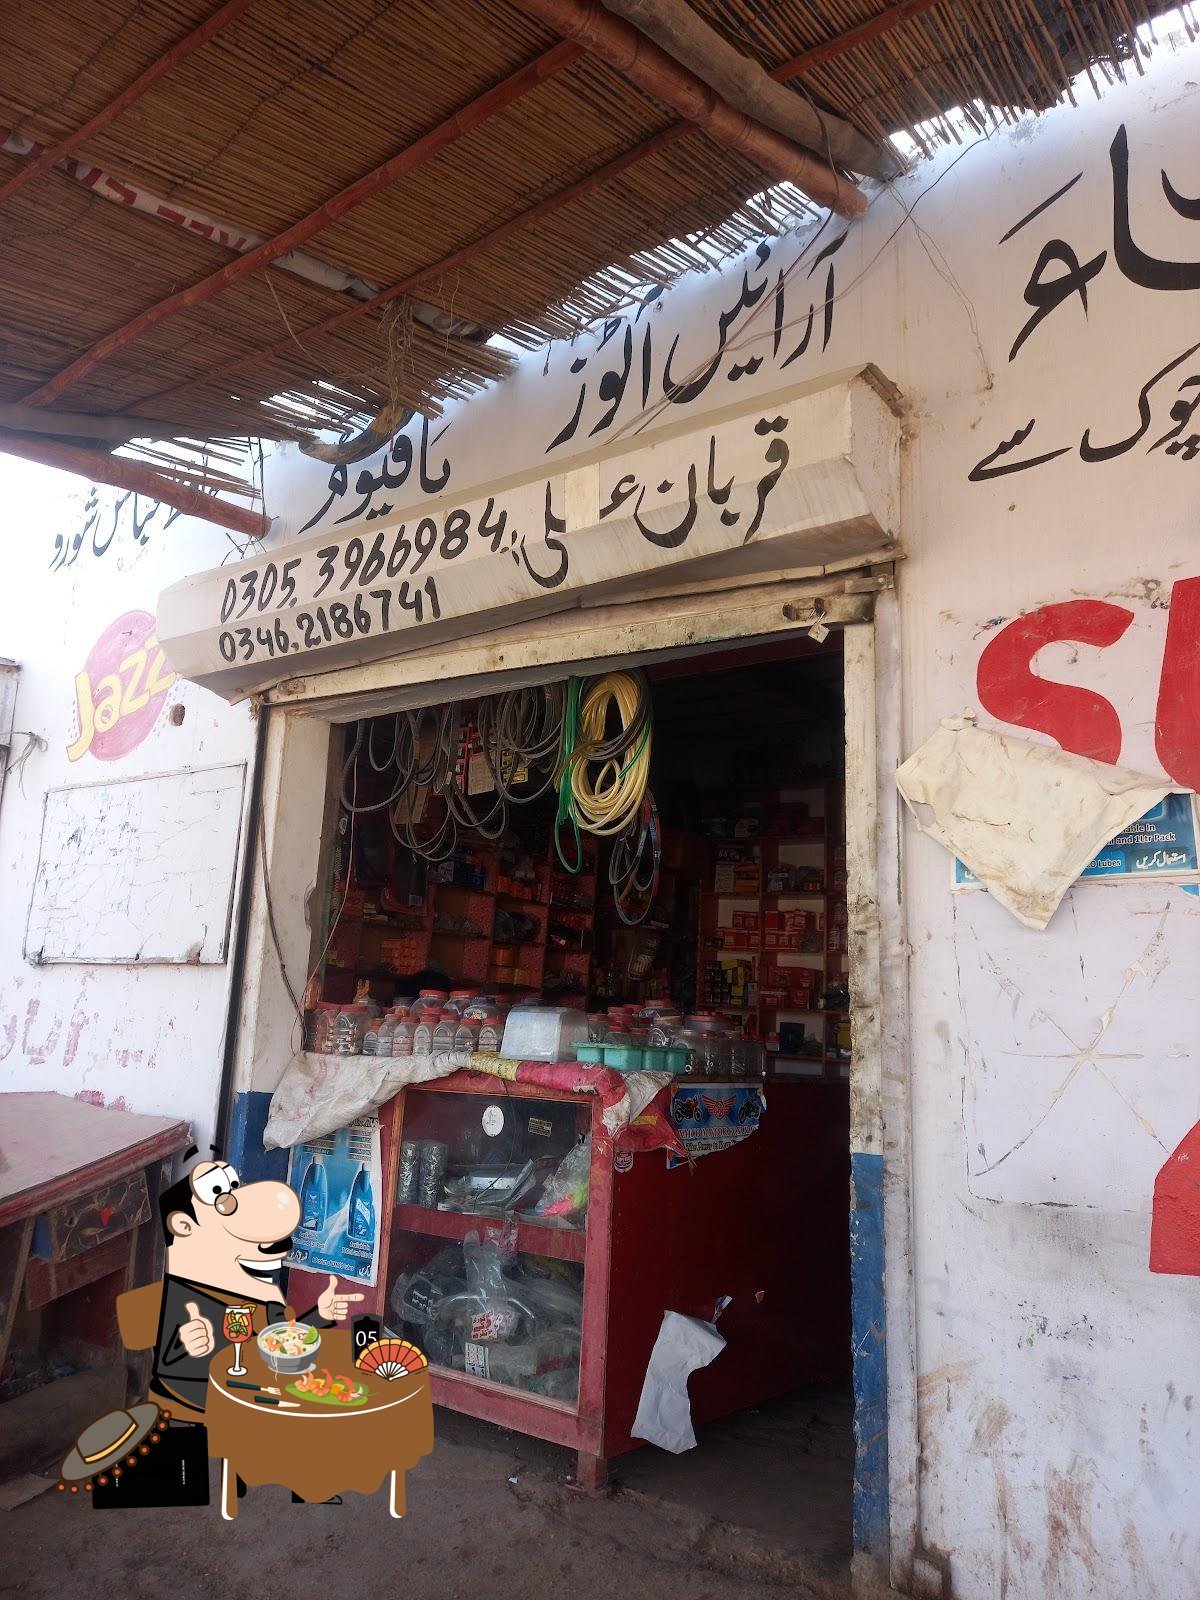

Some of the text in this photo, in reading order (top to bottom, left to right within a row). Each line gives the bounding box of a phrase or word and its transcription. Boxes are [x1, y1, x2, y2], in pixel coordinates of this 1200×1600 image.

[633, 416, 790, 548] قربان
[1116, 835, 1133, 845] and
[1154, 831, 1176, 842] Pack
[1098, 858, 1121, 867] Lubes
